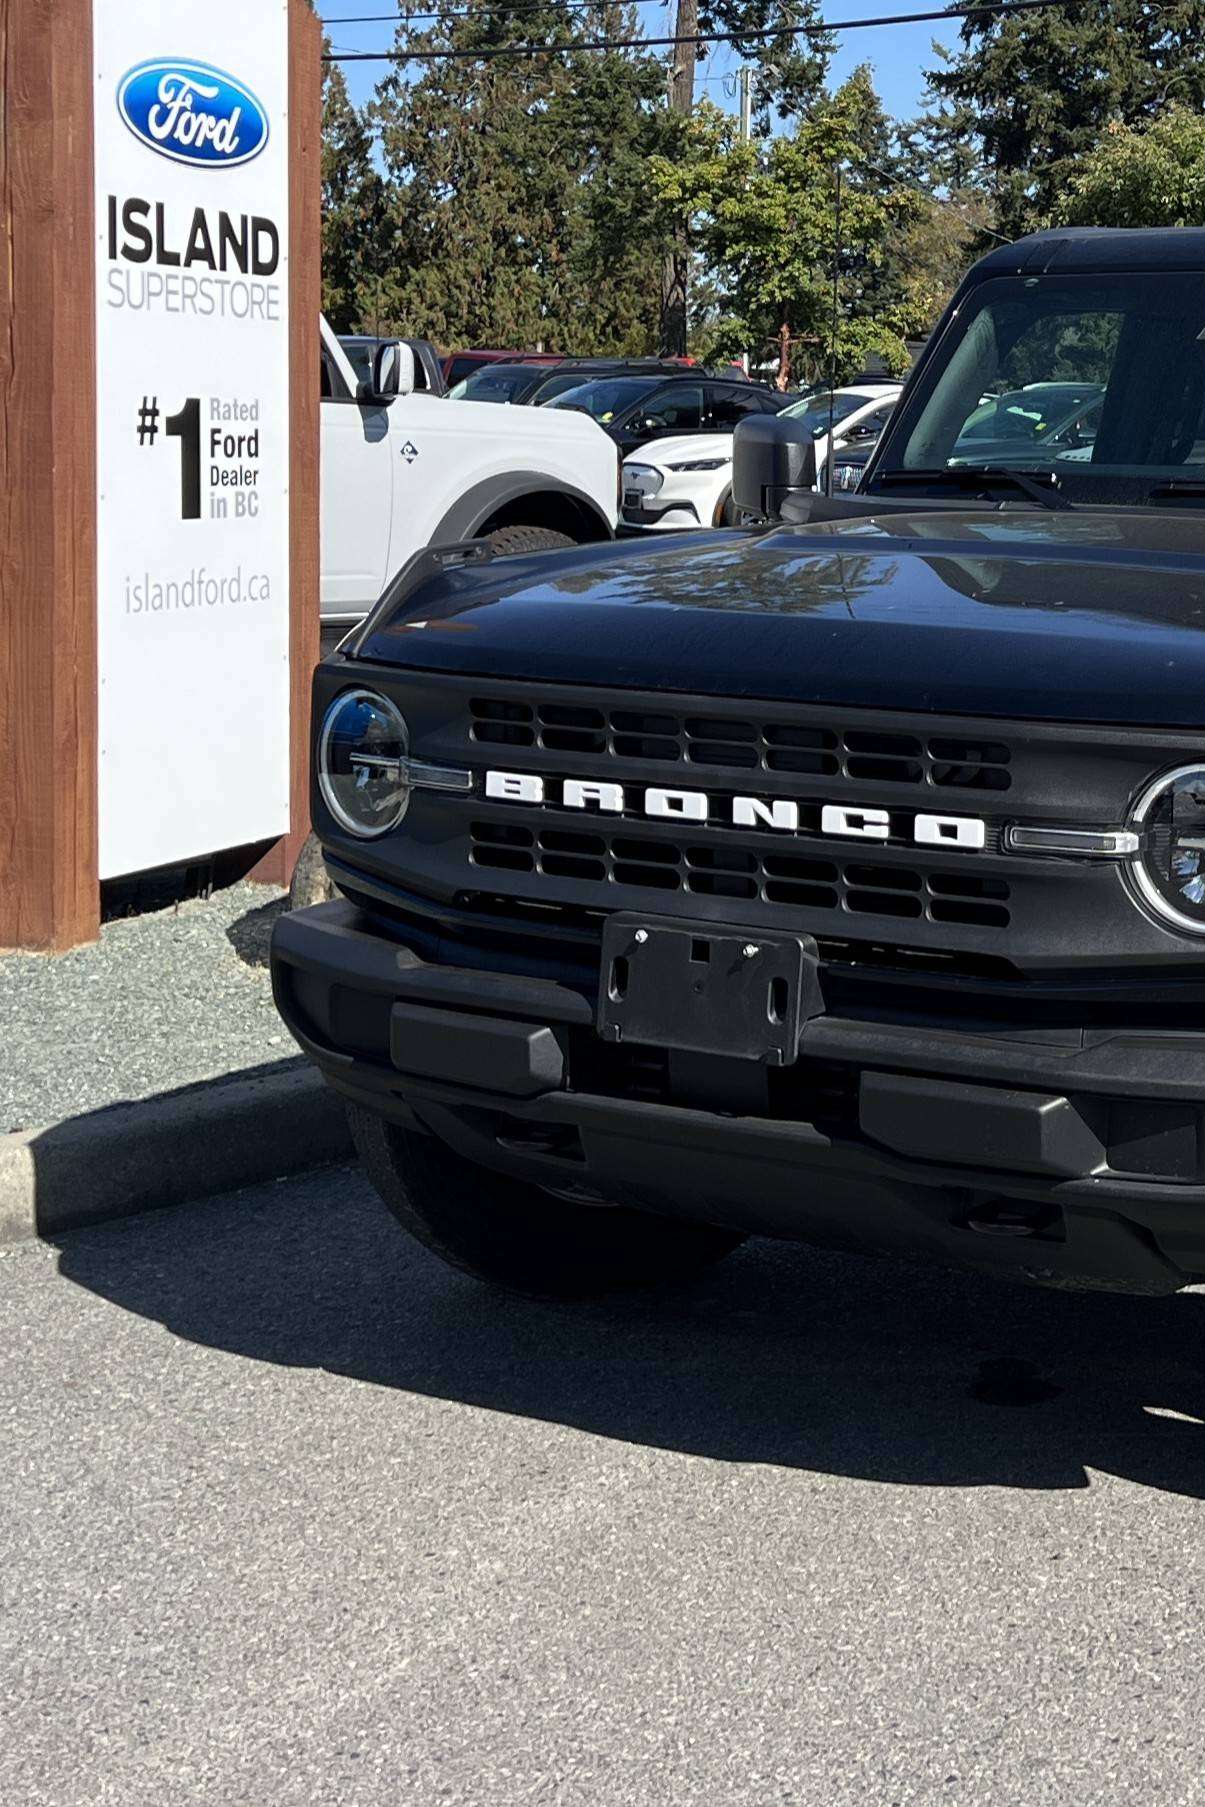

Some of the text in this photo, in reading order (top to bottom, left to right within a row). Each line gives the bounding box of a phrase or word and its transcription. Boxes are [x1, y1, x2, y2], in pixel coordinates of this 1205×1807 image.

[147, 73, 242, 154] Ford
[107, 194, 280, 277] ISLAND
[107, 267, 280, 321] SUPERSTORE
[209, 397, 260, 422] Rated
[209, 428, 260, 459] Ford
[209, 465, 260, 487] Dealer
[209, 490, 260, 520] in BC
[124, 565, 271, 615] islandford.ca
[484, 769, 986, 850] BRONCO
